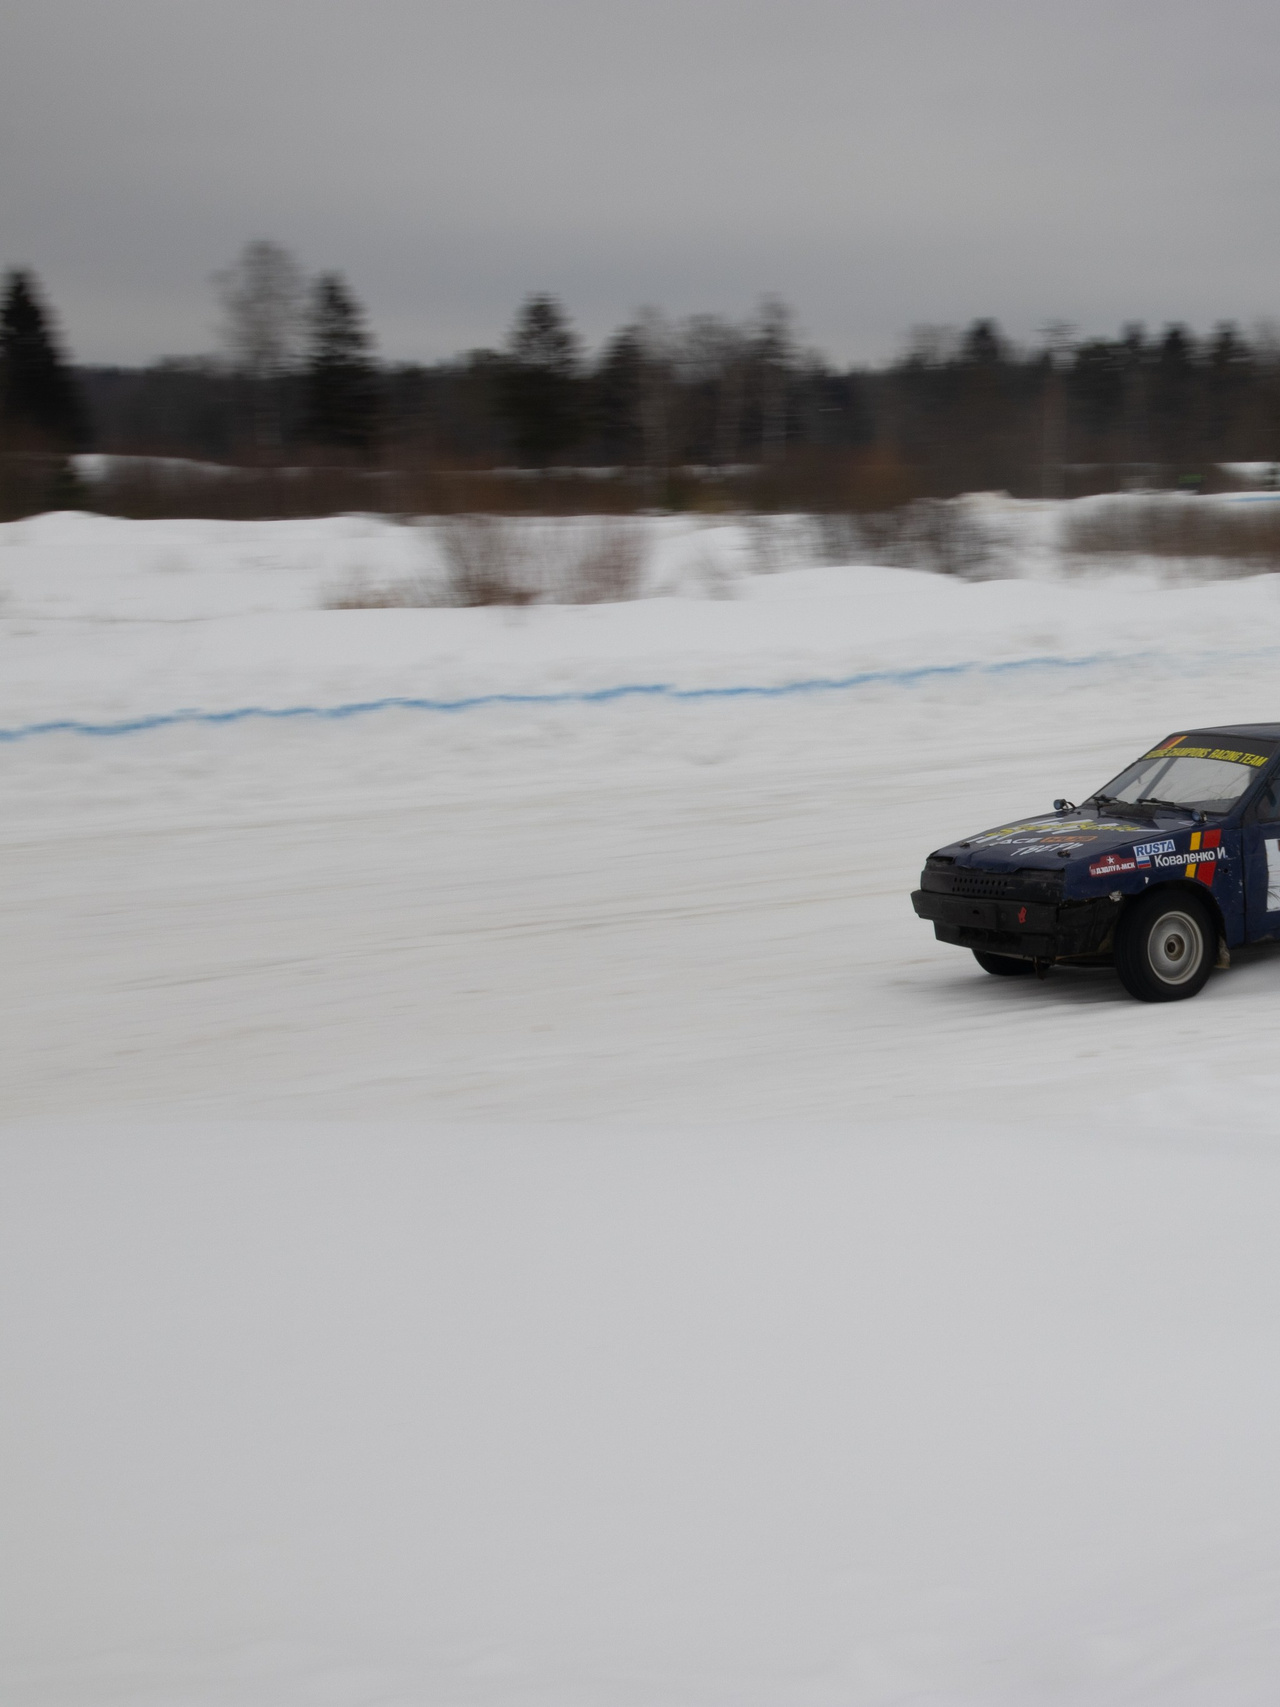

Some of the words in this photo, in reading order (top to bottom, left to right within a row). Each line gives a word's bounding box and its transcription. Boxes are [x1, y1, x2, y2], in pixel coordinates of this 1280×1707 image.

[1208, 749, 1243, 761] RACING
[1239, 753, 1269, 767] TEAM
[1136, 841, 1175, 857] RUSTA
[1154, 850, 1216, 868] Коваленко
